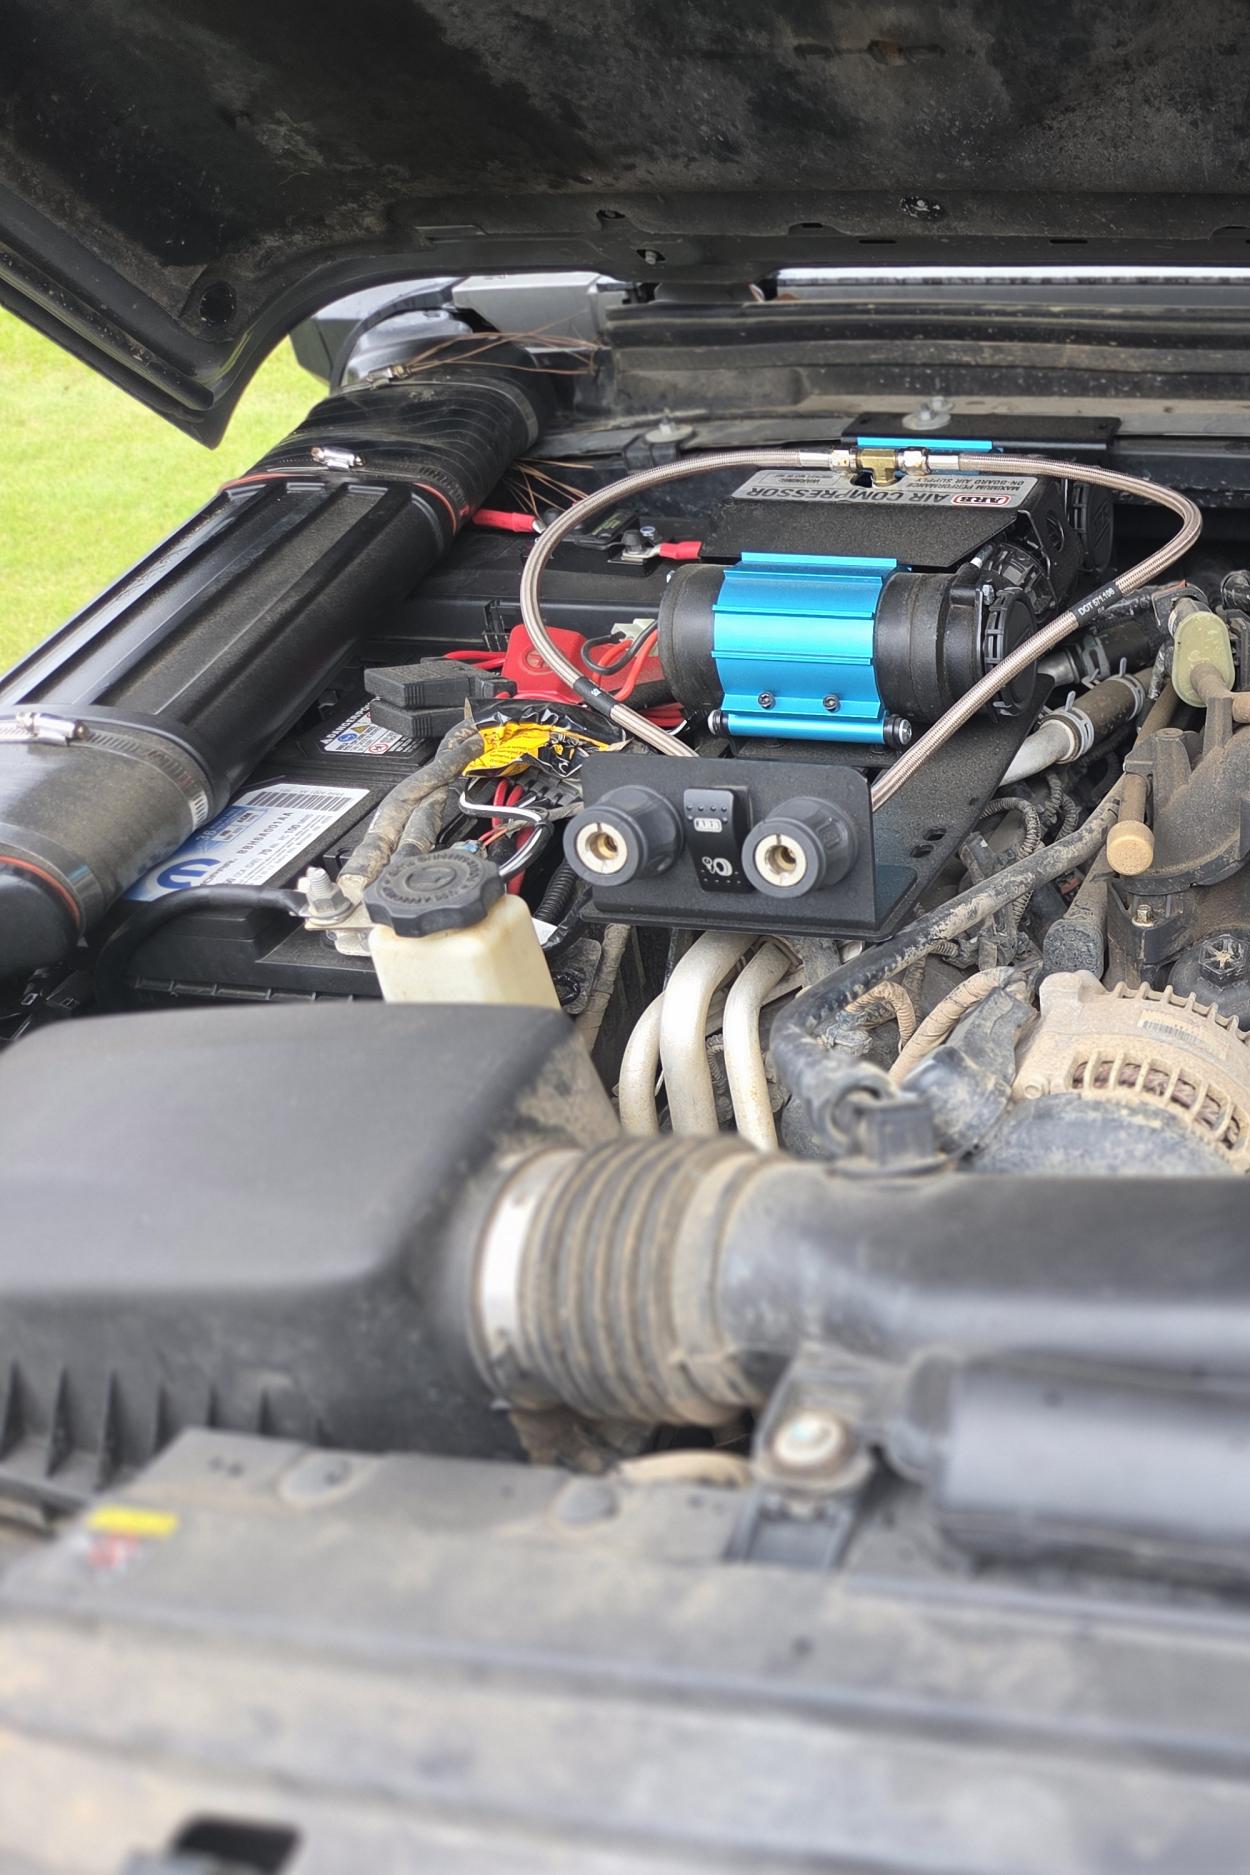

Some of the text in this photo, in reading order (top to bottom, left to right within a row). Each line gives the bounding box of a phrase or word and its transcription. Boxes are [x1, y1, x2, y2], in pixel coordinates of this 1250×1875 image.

[905, 482, 1021, 492] MAXIMUM PERFORMANCE
[746, 487, 950, 503] AIR COMPRESSOR
[959, 495, 1002, 504] ARB
[1077, 601, 1093, 616] DOT
